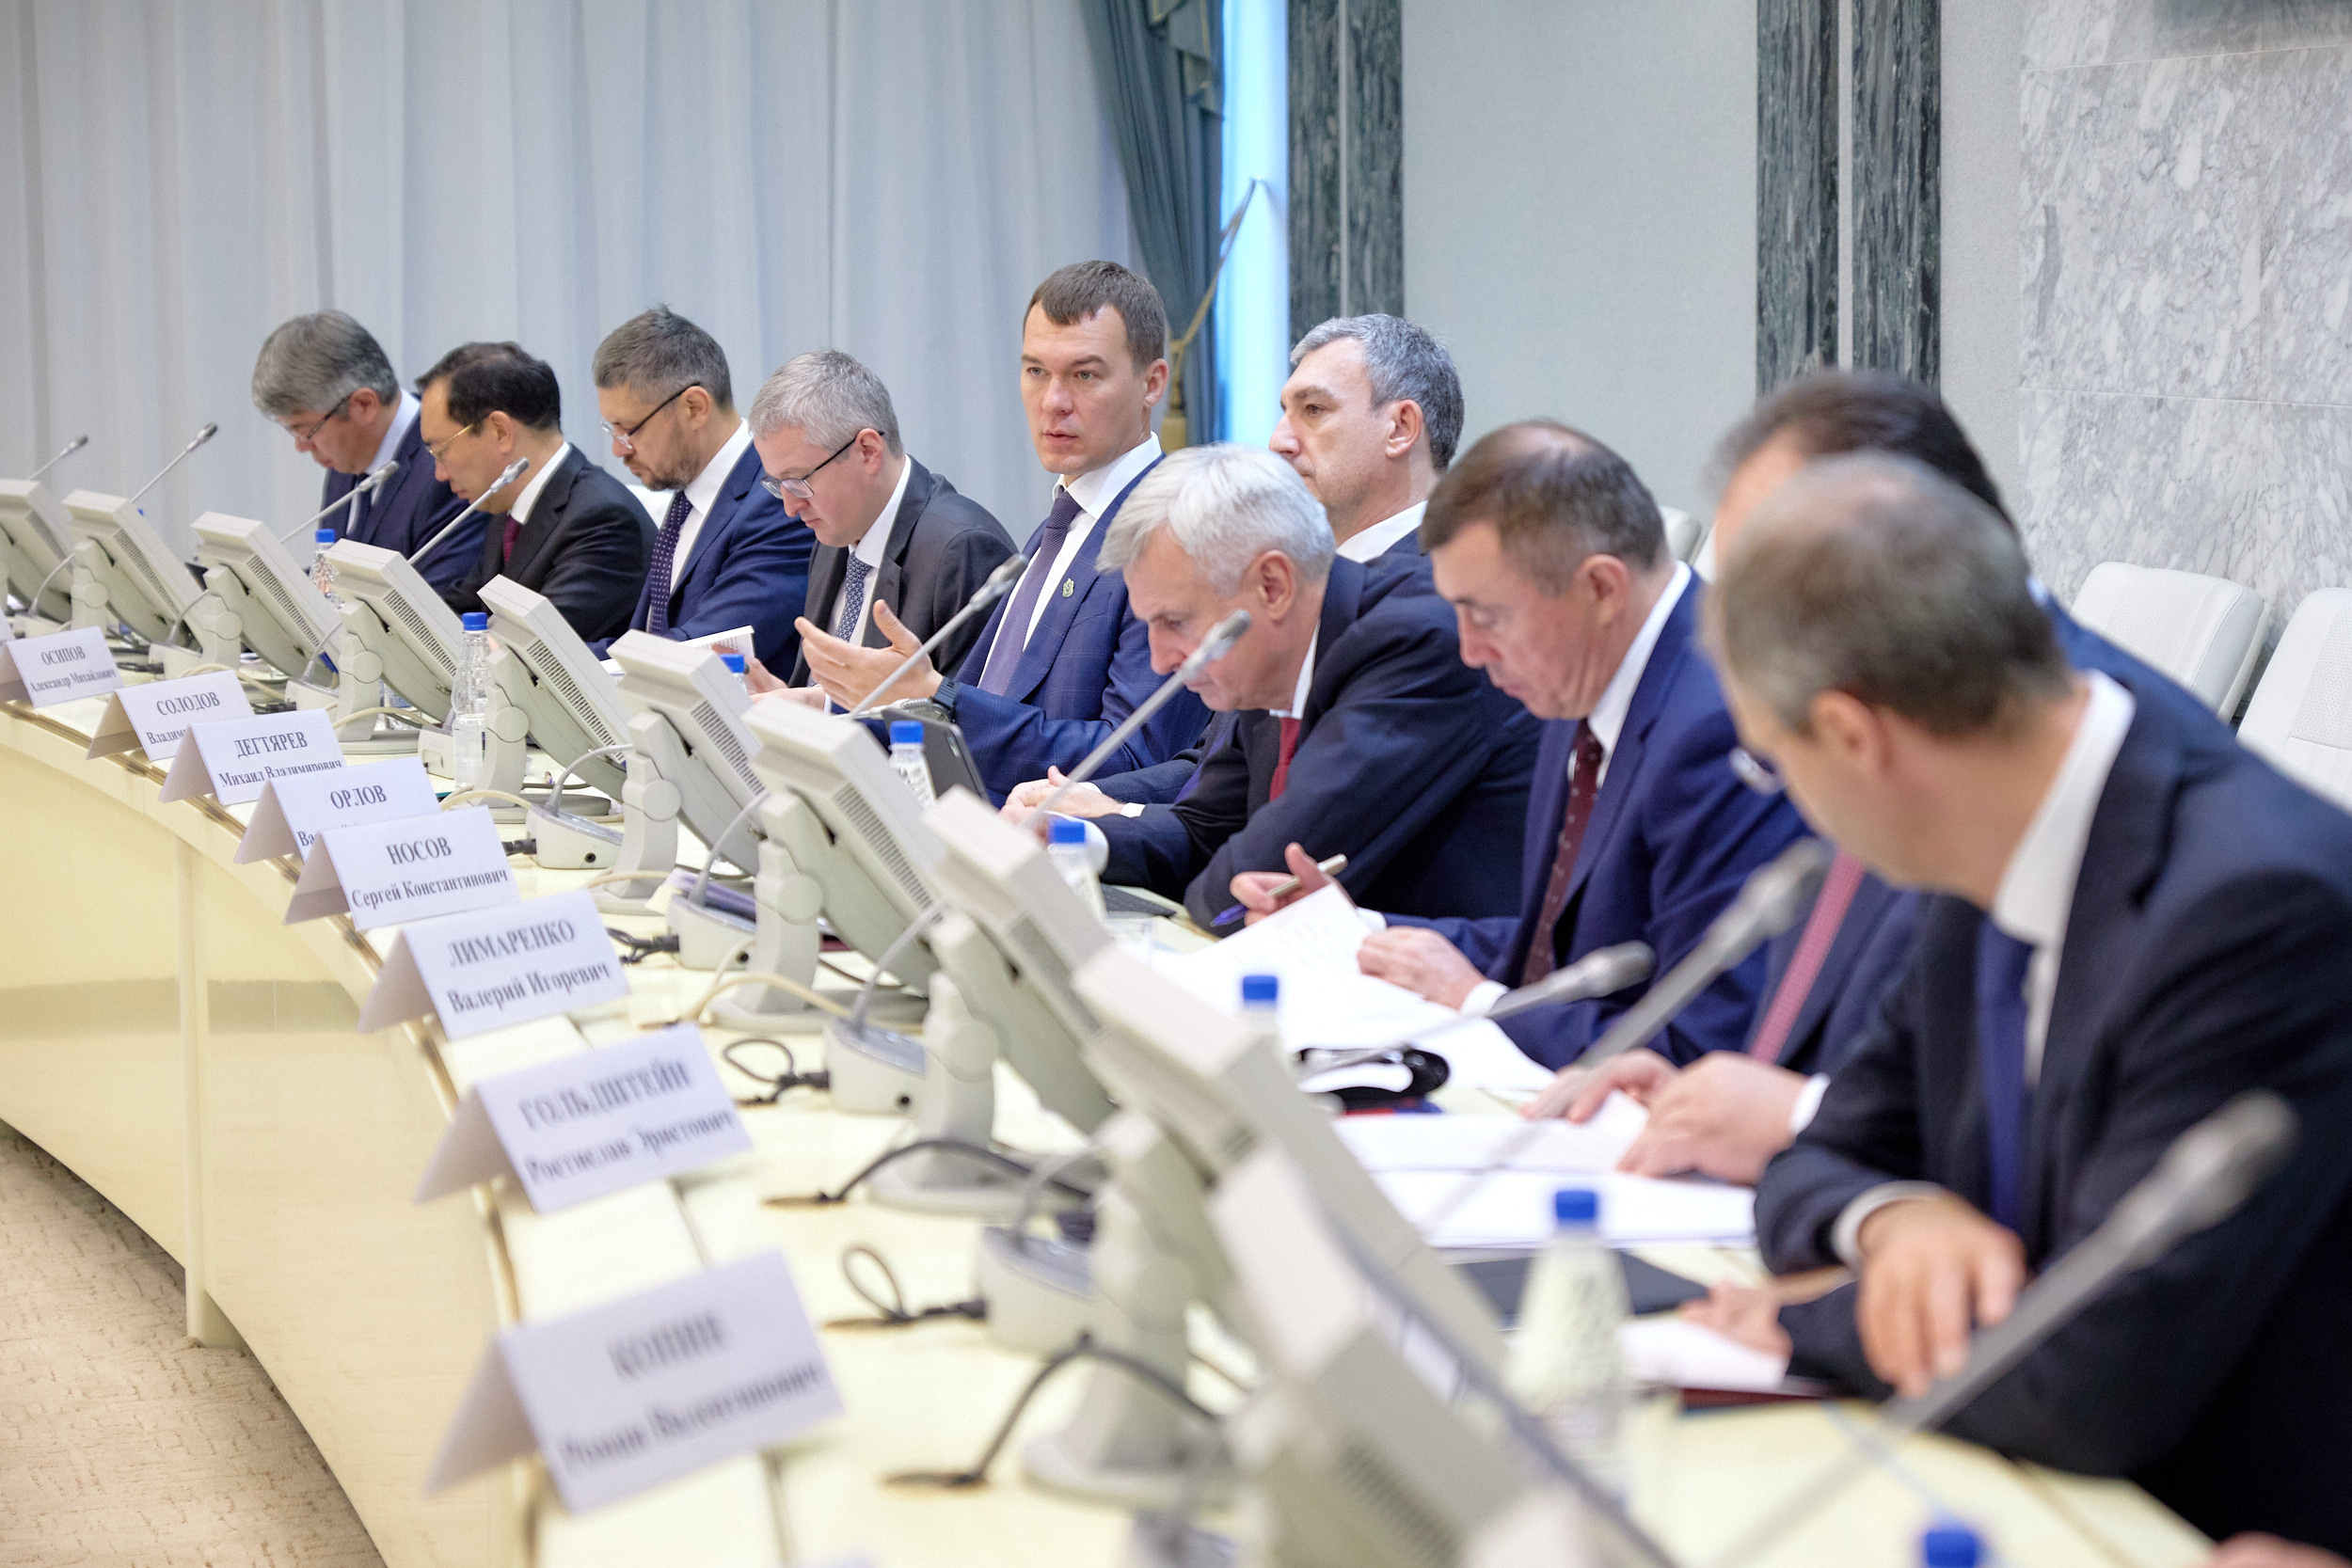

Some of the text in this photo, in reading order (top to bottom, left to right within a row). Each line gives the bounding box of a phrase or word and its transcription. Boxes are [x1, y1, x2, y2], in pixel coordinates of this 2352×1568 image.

[40, 645, 86, 666] ОСИПОВ
[30, 669, 118, 693] Александр Михайлович
[156, 691, 220, 716] СОЛОДОВ
[232, 731, 308, 758] ДЕГТЯРЕВ
[218, 769, 265, 788] Михаил
[330, 784, 387, 809] ОРЛОВ
[386, 836, 452, 865] НОСОВ
[352, 869, 509, 911] Сергей Константинович
[448, 917, 576, 968] ЛИМАРЕНКО
[445, 961, 612, 1014] Валерий Игоревич
[519, 1059, 691, 1129] ГОЛЬДШТЕЙН
[524, 1139, 632, 1183] Ростислав
